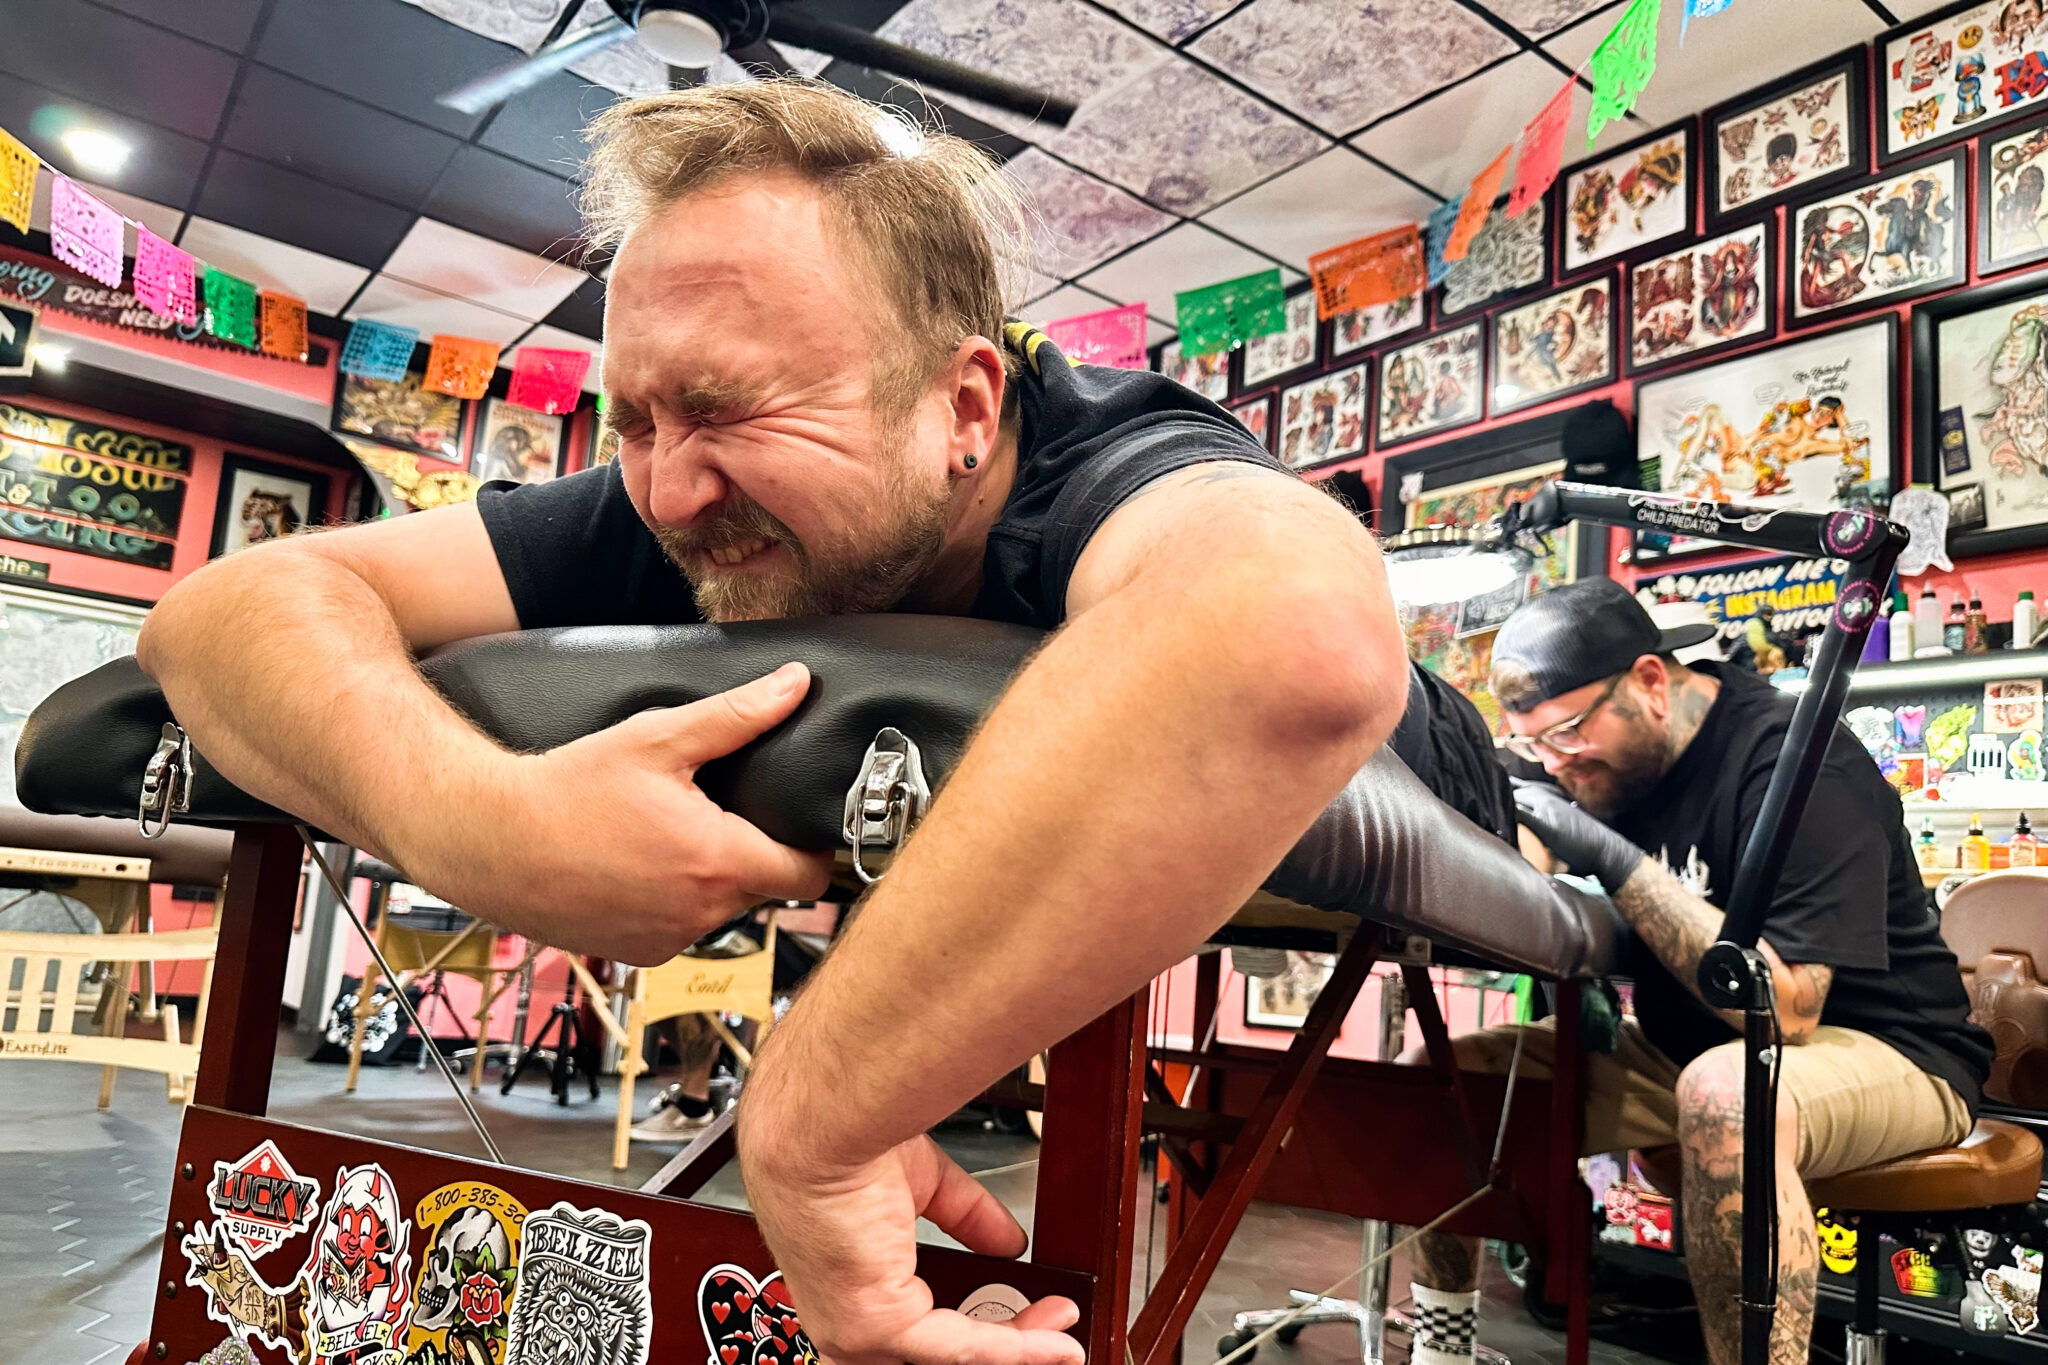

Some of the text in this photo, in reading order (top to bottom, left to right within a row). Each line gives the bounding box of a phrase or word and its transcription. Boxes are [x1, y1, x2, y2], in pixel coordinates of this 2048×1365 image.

[64, 285, 143, 309] DOESN
[1636, 507, 1667, 525] CHILD
[1666, 511, 1721, 535] PREDATOR
[1692, 564, 1785, 600] FOLLOW
[1785, 557, 1830, 582] ME
[1725, 579, 1837, 618] INSTAGRAM
[214, 1167, 316, 1225] LUCKY
[232, 1221, 282, 1242] SUPPLY
[529, 1222, 642, 1278] BELZEL
[326, 1323, 383, 1352] BELZEL
